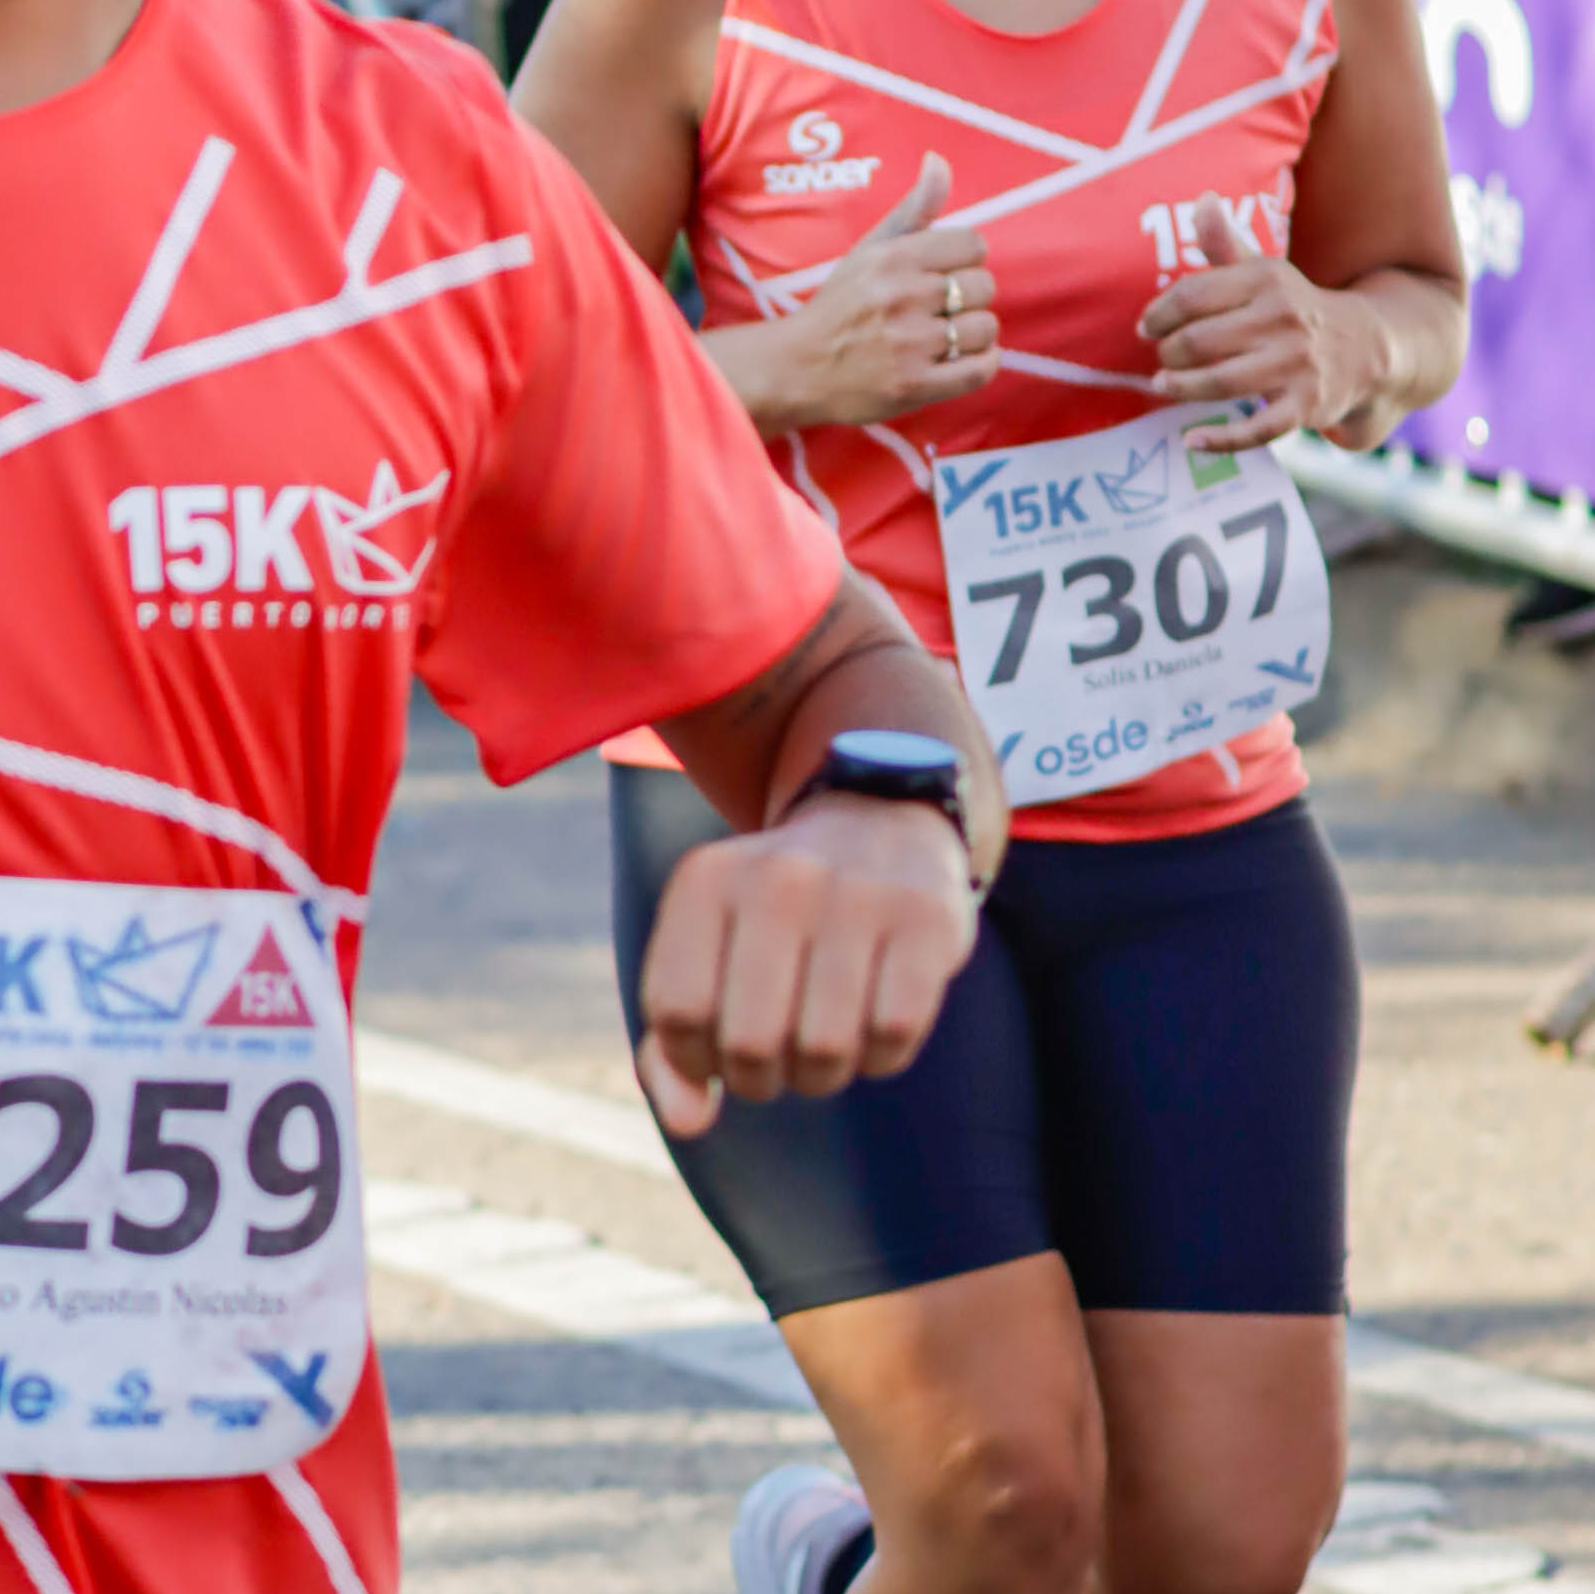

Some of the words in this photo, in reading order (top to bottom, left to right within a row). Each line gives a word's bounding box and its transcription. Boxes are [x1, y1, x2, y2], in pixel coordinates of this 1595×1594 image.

[108, 484, 314, 593] 15K
[984, 476, 1090, 539] 15K
[136, 600, 312, 630] PUERTO
[967, 501, 1289, 688] 7307
[1035, 718, 1148, 777] osde
